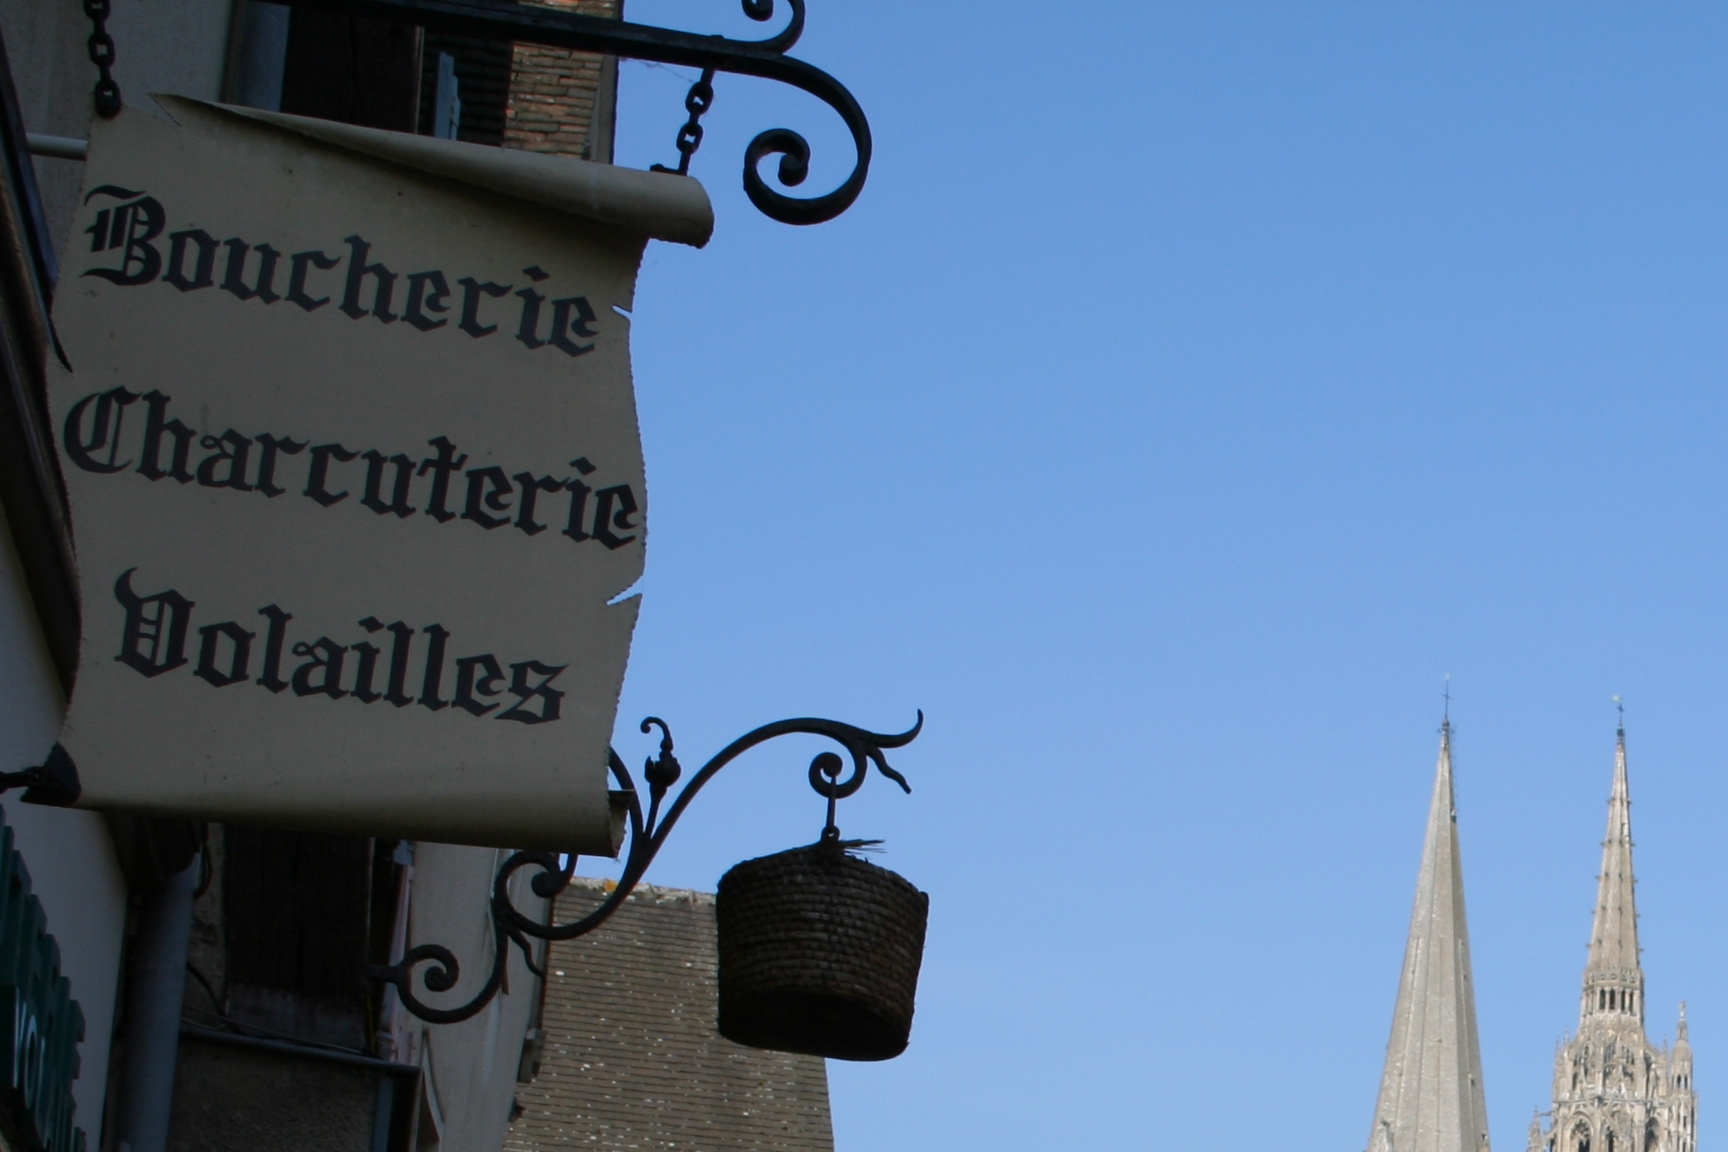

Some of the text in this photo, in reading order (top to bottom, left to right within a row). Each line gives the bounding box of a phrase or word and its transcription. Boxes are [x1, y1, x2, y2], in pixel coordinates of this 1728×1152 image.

[83, 185, 599, 357] Boucherie
[63, 385, 639, 550] Charcuterie
[114, 567, 569, 725] Volailles
